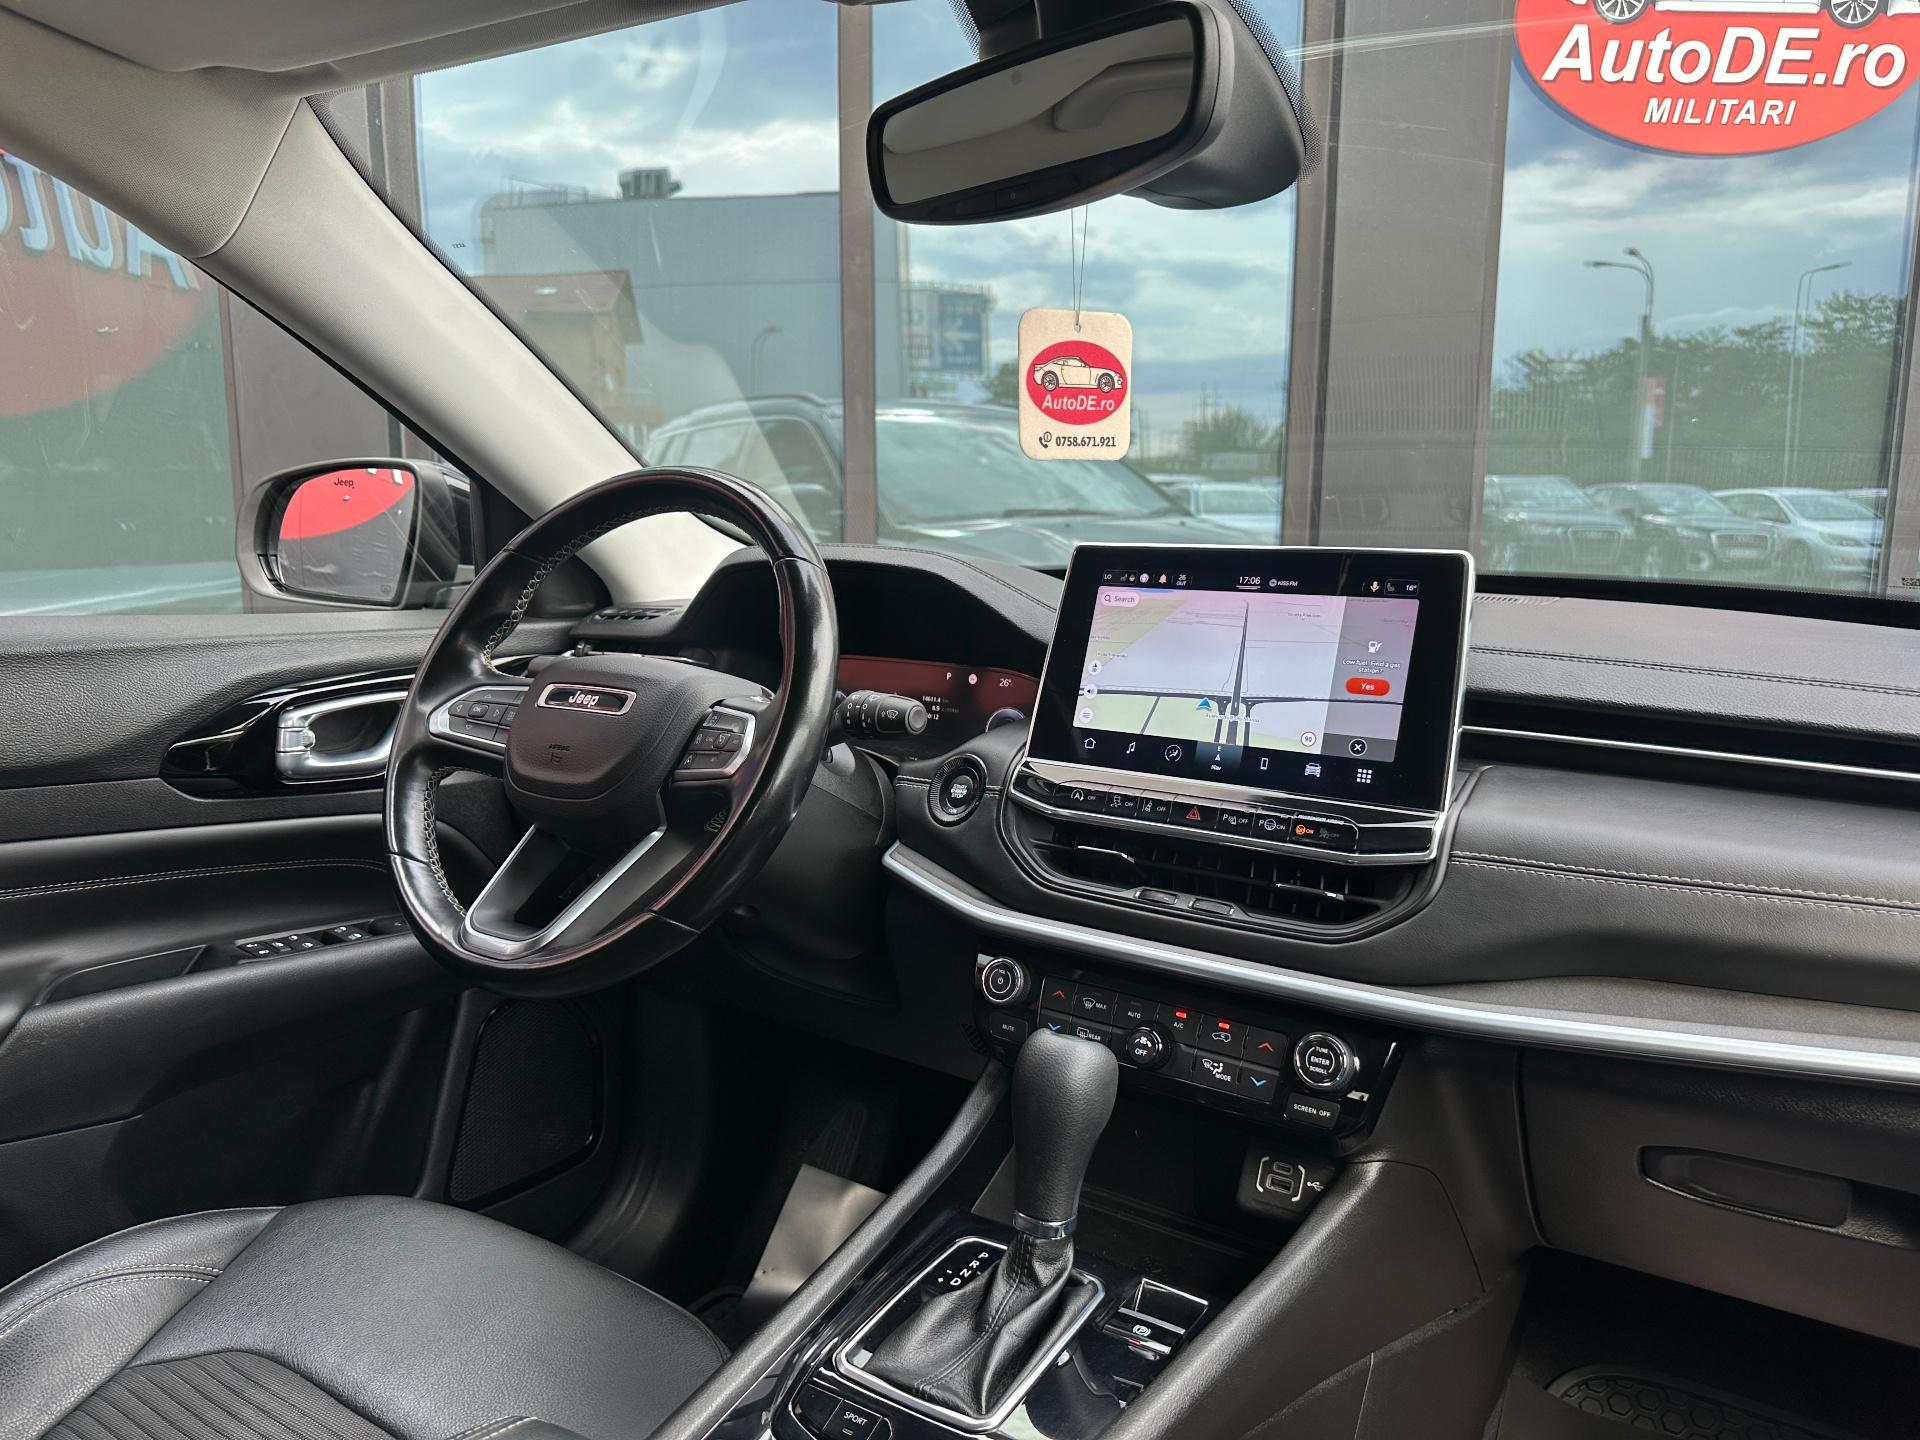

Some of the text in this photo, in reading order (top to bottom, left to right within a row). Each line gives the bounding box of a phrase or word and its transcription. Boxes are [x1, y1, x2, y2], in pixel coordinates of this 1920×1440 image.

[1542, 24, 1907, 89] AutoDE.ro
[1643, 98, 1796, 126] MILITARI
[1042, 394, 1115, 411] AutoDE.ro
[1055, 436, 1117, 447] 0758.671.921
[334, 478, 354, 488] Jeep
[1238, 576, 1261, 585] 17:06
[1114, 595, 1135, 603] Search
[1361, 682, 1376, 691] Yes
[568, 691, 600, 708] Jeep
[1095, 1002, 1108, 1010] MAX
[1127, 1011, 1141, 1019] AUTO
[1002, 1023, 1016, 1032] MUTE
[1173, 1021, 1184, 1029] A/C
[1134, 1047, 1148, 1057] OFF
[1315, 1045, 1329, 1054] TUNE
[1310, 1055, 1330, 1066] ENTER
[1309, 1065, 1328, 1075] SCROLL
[1215, 1072, 1232, 1082] MODE
[1293, 1103, 1332, 1118] SCREEN OFF
[843, 1411, 869, 1426] SPORT
